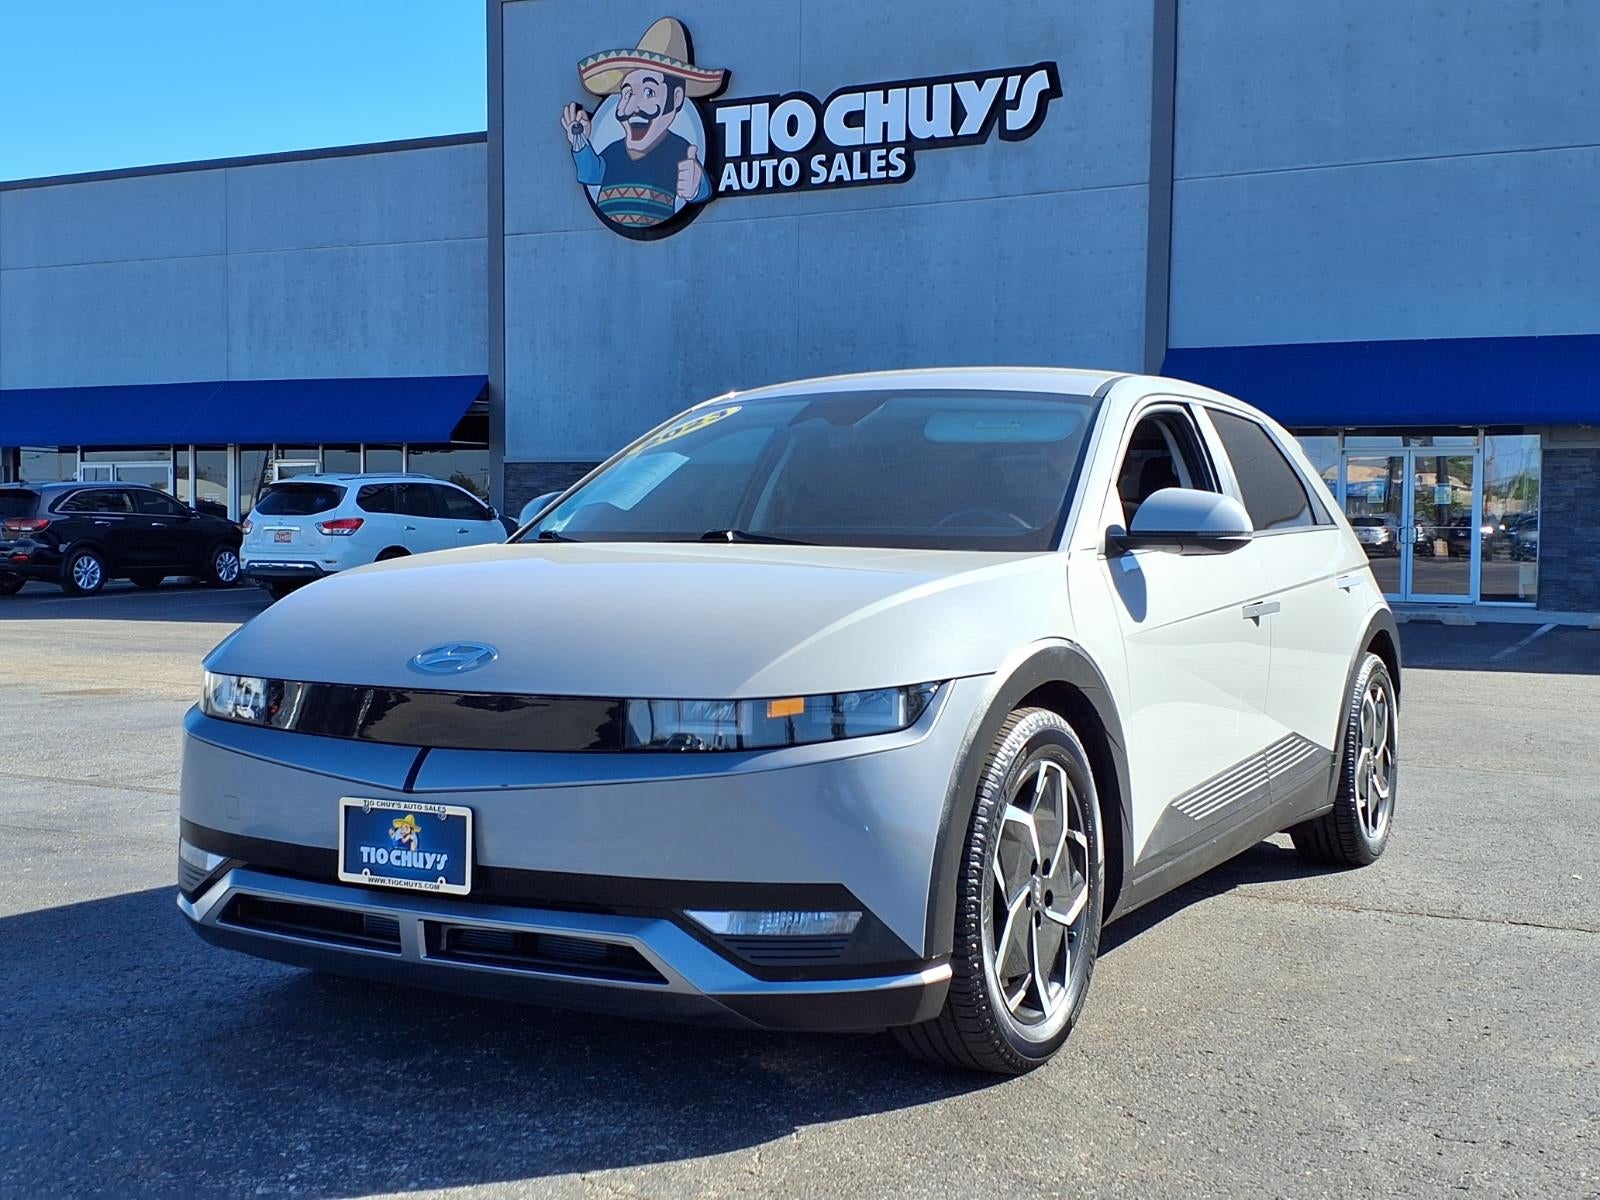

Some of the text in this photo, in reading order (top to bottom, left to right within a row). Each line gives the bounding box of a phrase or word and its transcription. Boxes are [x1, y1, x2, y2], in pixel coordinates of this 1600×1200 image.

[715, 69, 1050, 157] TIO CHUY'S
[718, 147, 906, 192] AUTO SALES
[363, 799, 375, 807] TIO
[403, 803, 422, 811] AUTO
[424, 805, 447, 813] SALES
[360, 846, 389, 865] TIO
[367, 876, 440, 890] WWW.TIOCHUYS.COM
